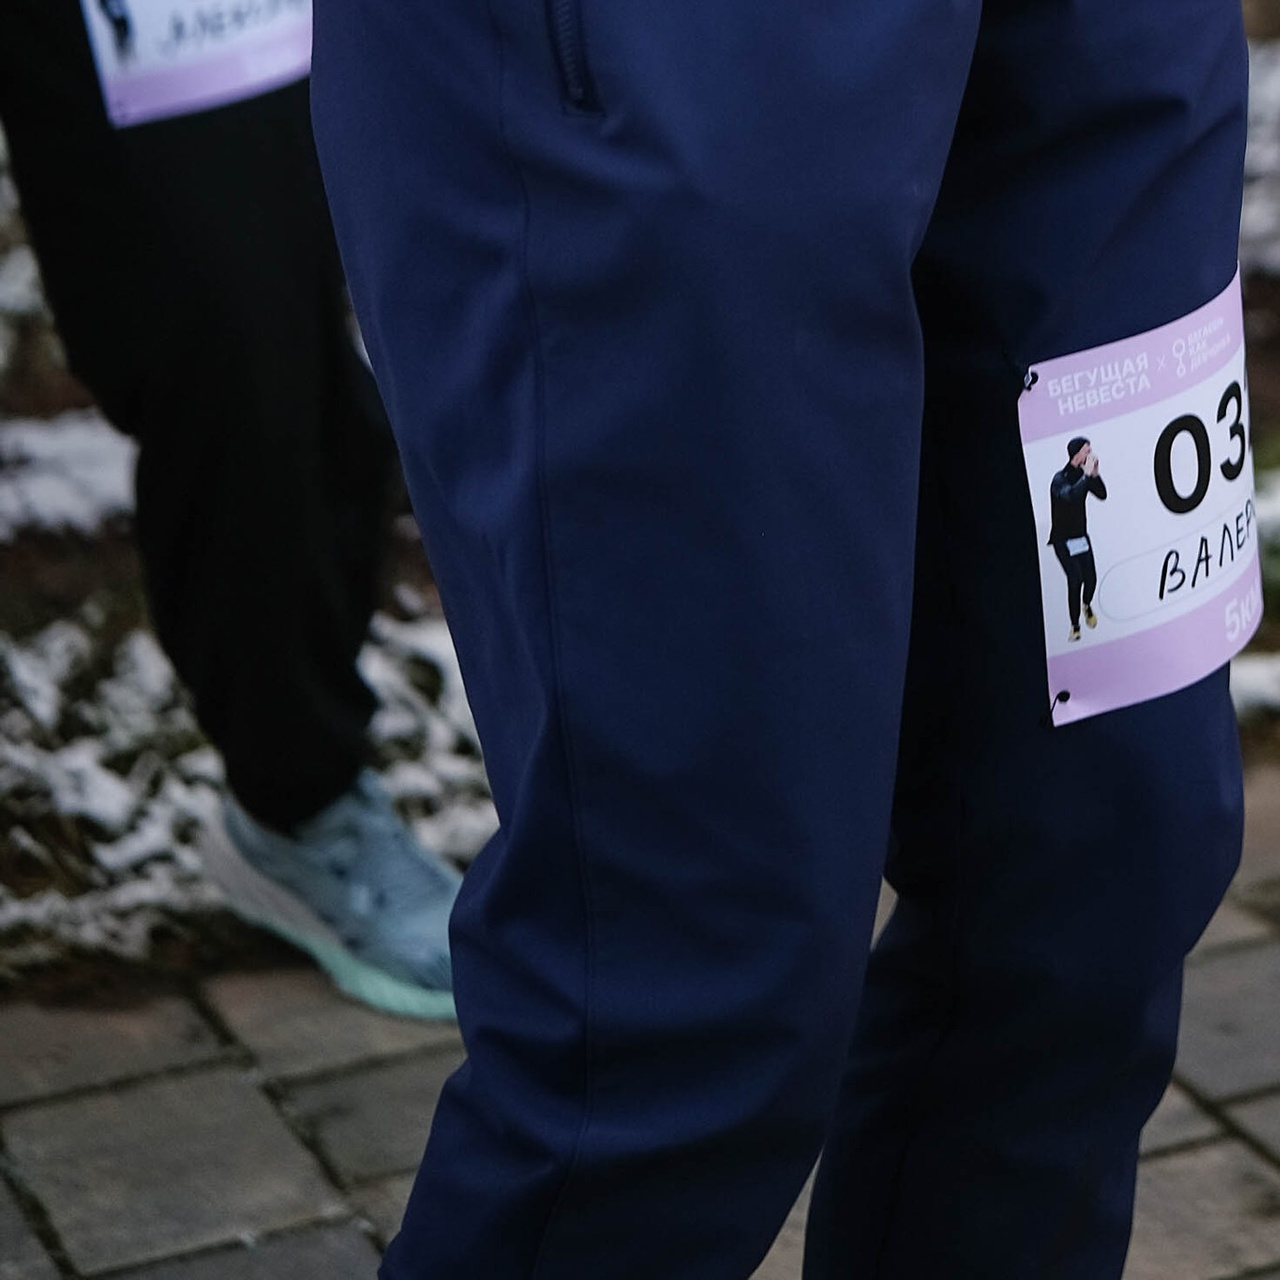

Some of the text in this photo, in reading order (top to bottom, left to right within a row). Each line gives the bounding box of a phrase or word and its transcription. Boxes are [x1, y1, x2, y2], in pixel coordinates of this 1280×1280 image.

[1047, 351, 1149, 398] БЕГУЩАЯ
[1058, 372, 1151, 416] НЕВЕСТА
[1153, 378, 1250, 515] 03
[1158, 498, 1256, 601] ВАЛЕР
